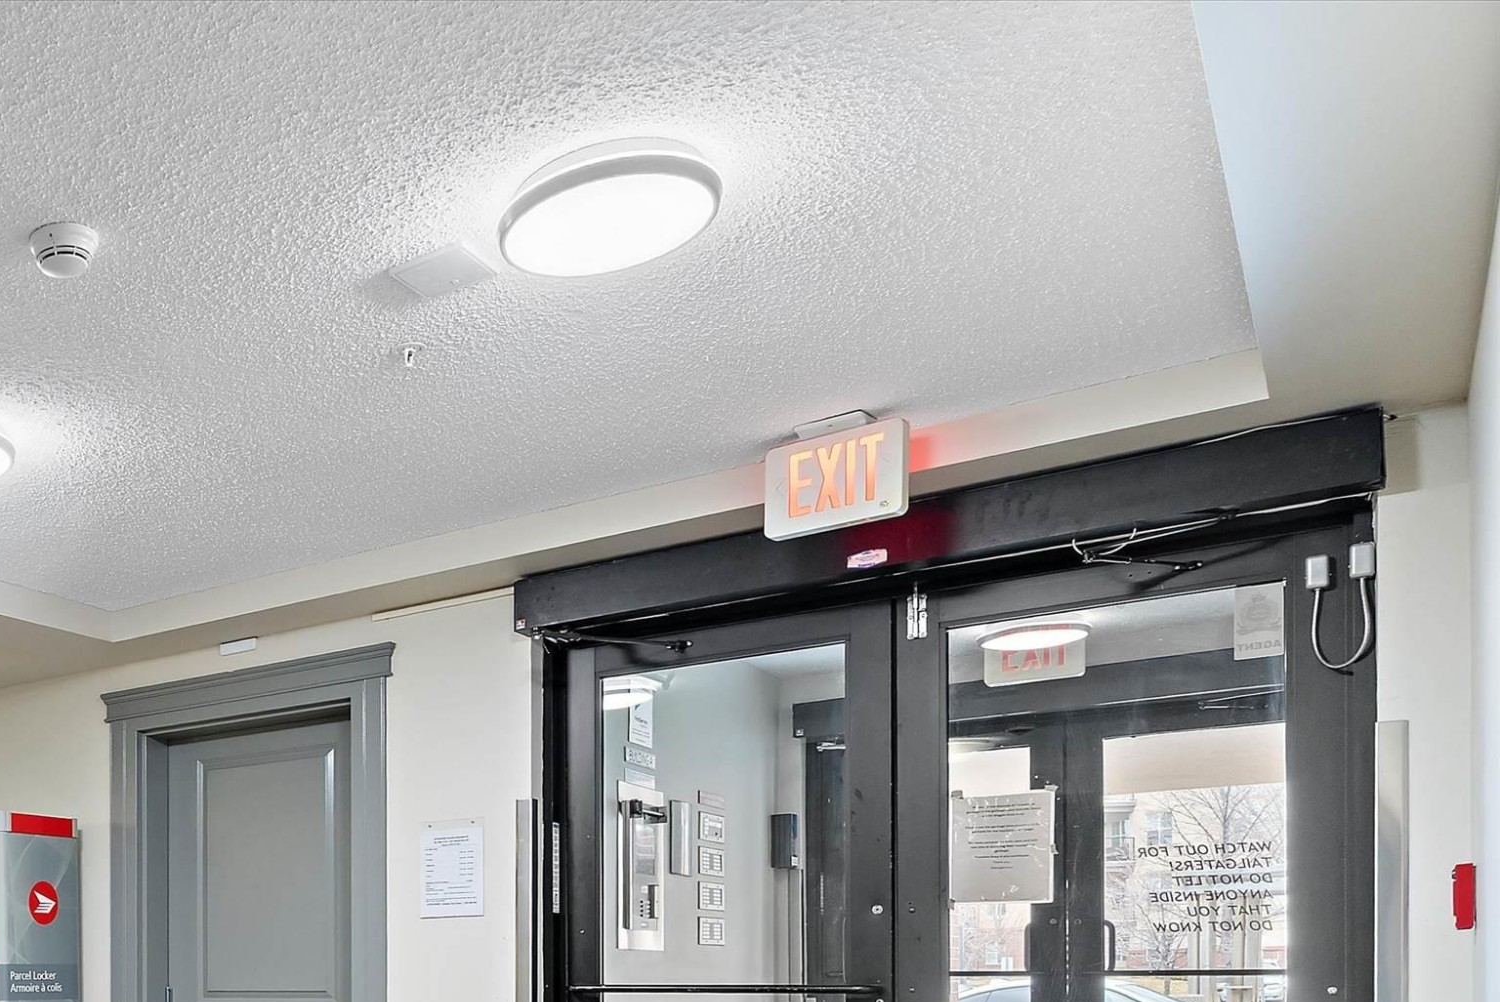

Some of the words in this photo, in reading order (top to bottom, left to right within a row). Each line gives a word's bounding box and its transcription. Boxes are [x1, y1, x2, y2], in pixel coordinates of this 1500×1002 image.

[788, 432, 884, 518] EXIT
[10, 970, 32, 981] Parcel
[33, 970, 57, 981] Locker
[10, 983, 40, 993] Armoire
[40, 982, 46, 993] à
[46, 982, 63, 993] colis
